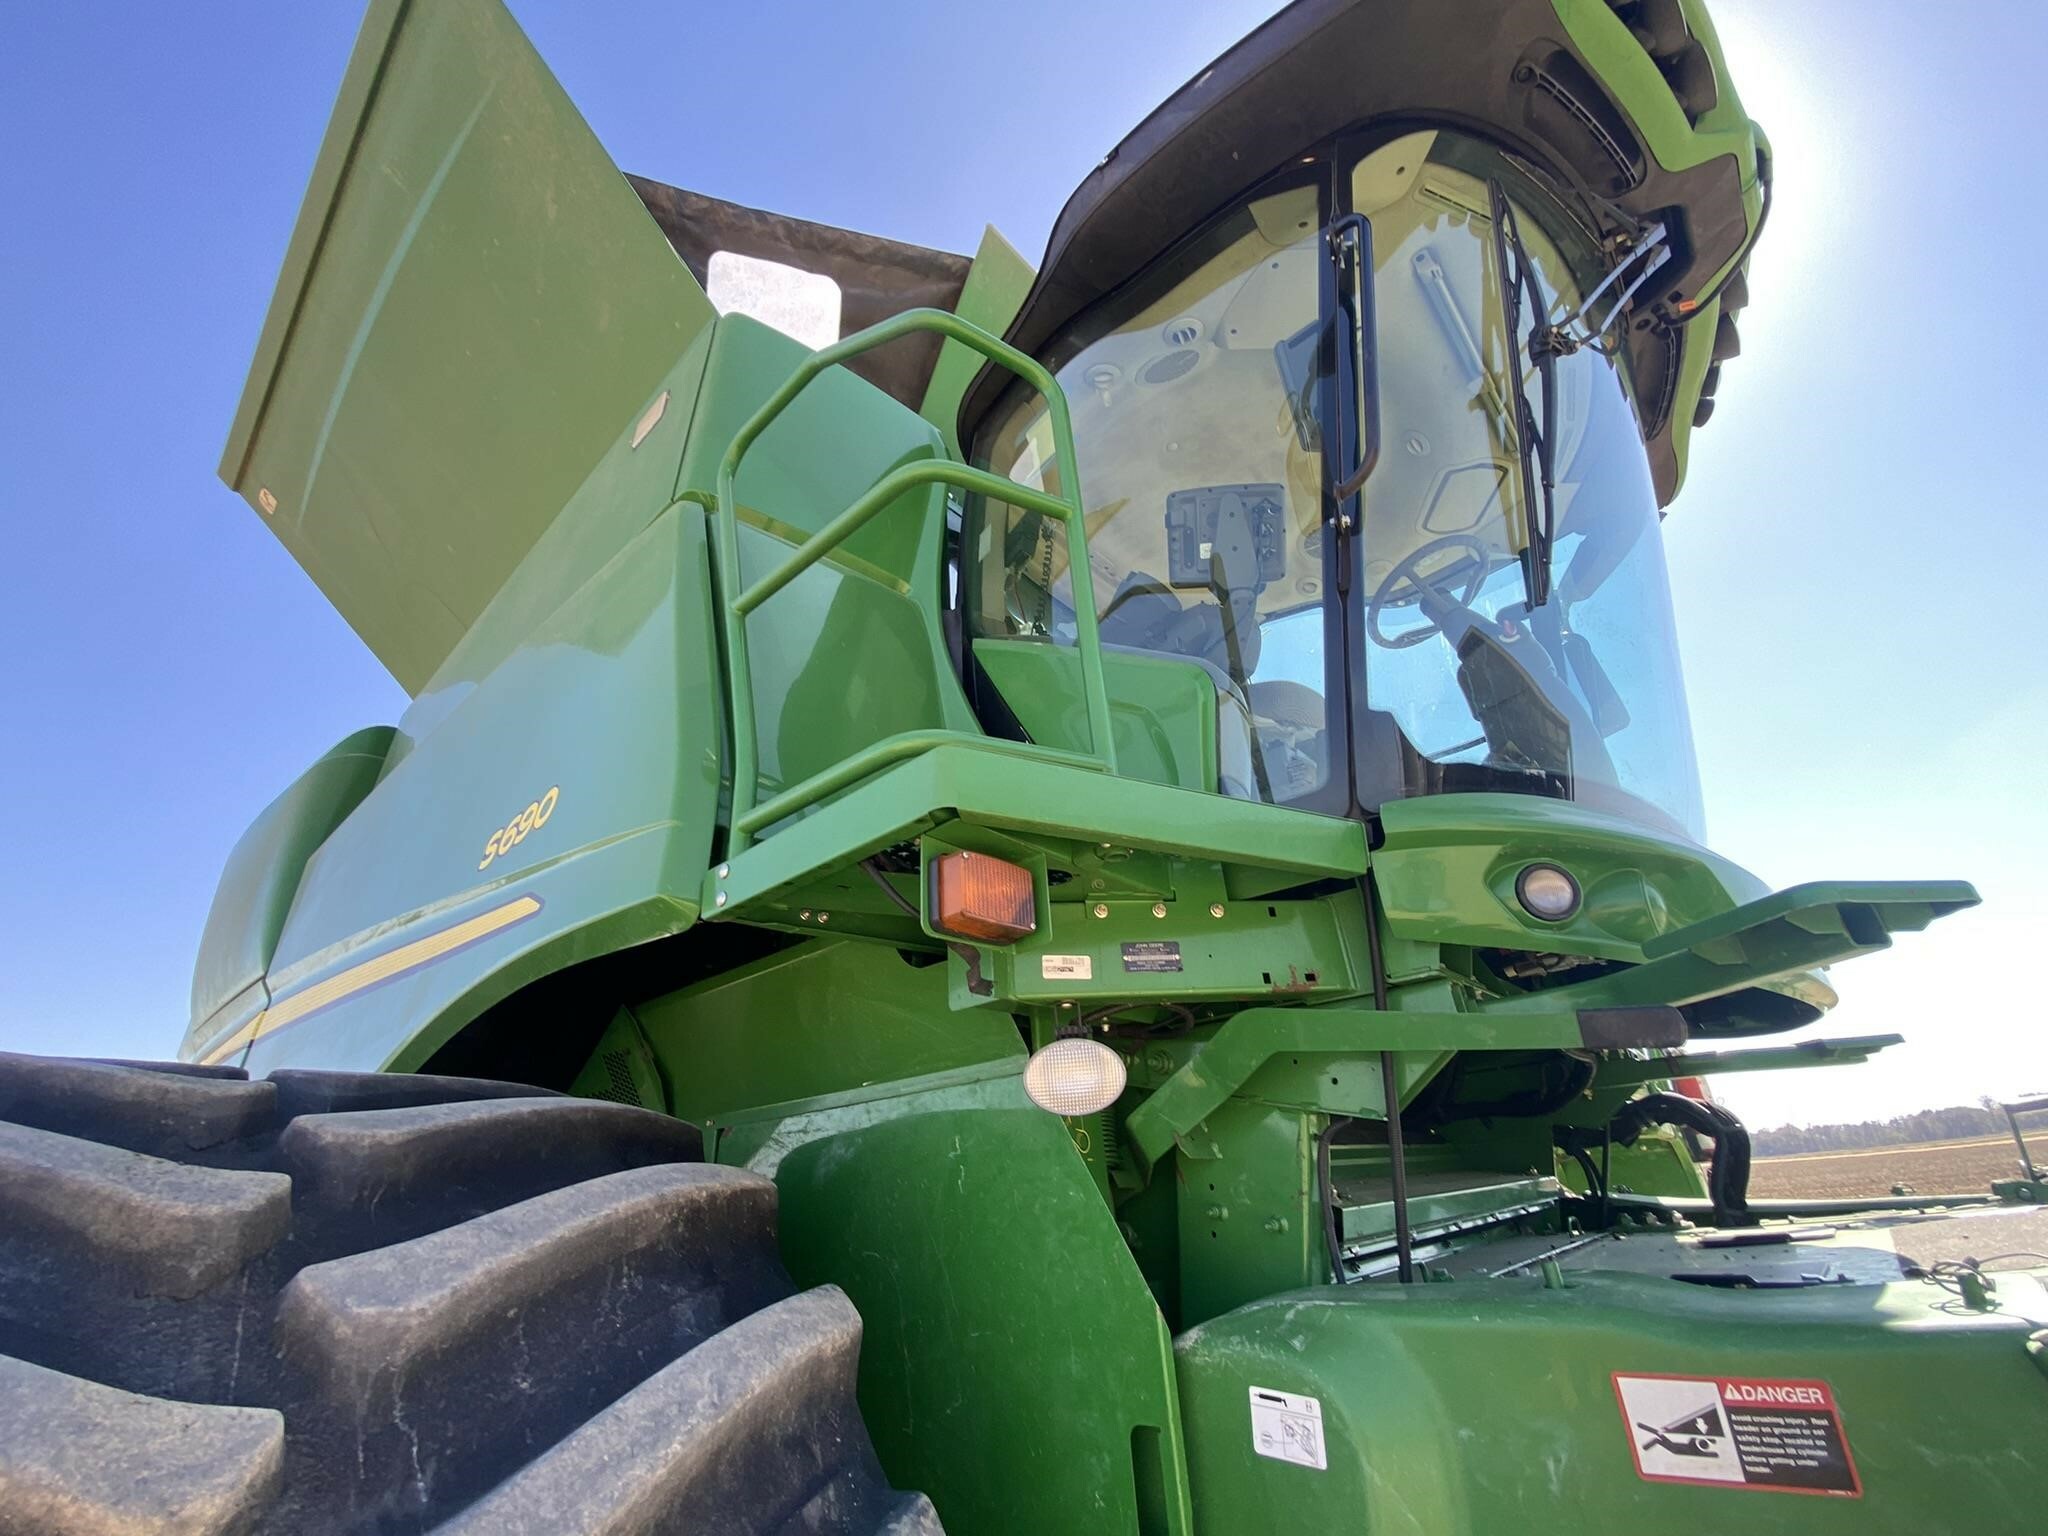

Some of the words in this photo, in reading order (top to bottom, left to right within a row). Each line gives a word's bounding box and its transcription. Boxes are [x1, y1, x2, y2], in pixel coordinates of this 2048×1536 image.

[478, 786, 559, 870] S690
[1740, 1385, 1825, 1404] DANGER
[1731, 1413, 1751, 1422] Avoid
[1752, 1415, 1785, 1425] crushing
